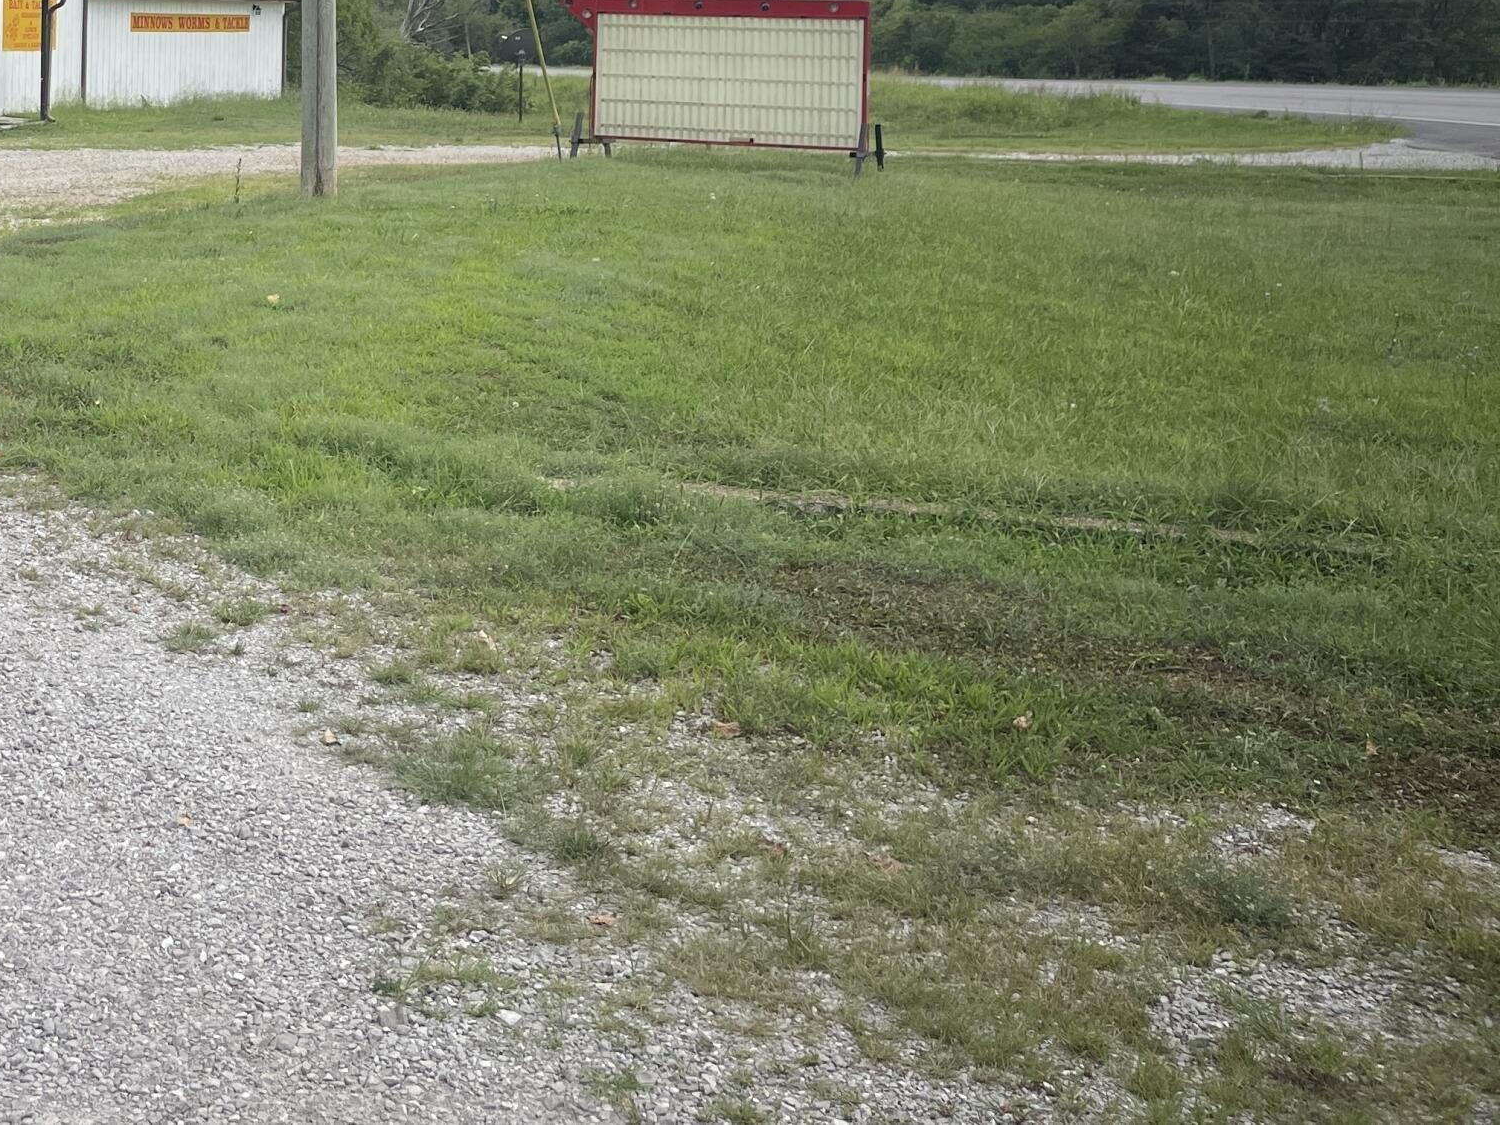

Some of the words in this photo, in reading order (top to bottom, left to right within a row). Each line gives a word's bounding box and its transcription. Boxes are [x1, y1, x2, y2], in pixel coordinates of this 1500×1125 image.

[132, 15, 173, 29] MINNOWS
[179, 17, 211, 30] WORMS
[214, 17, 221, 29] &
[223, 17, 249, 30] TACKLE
